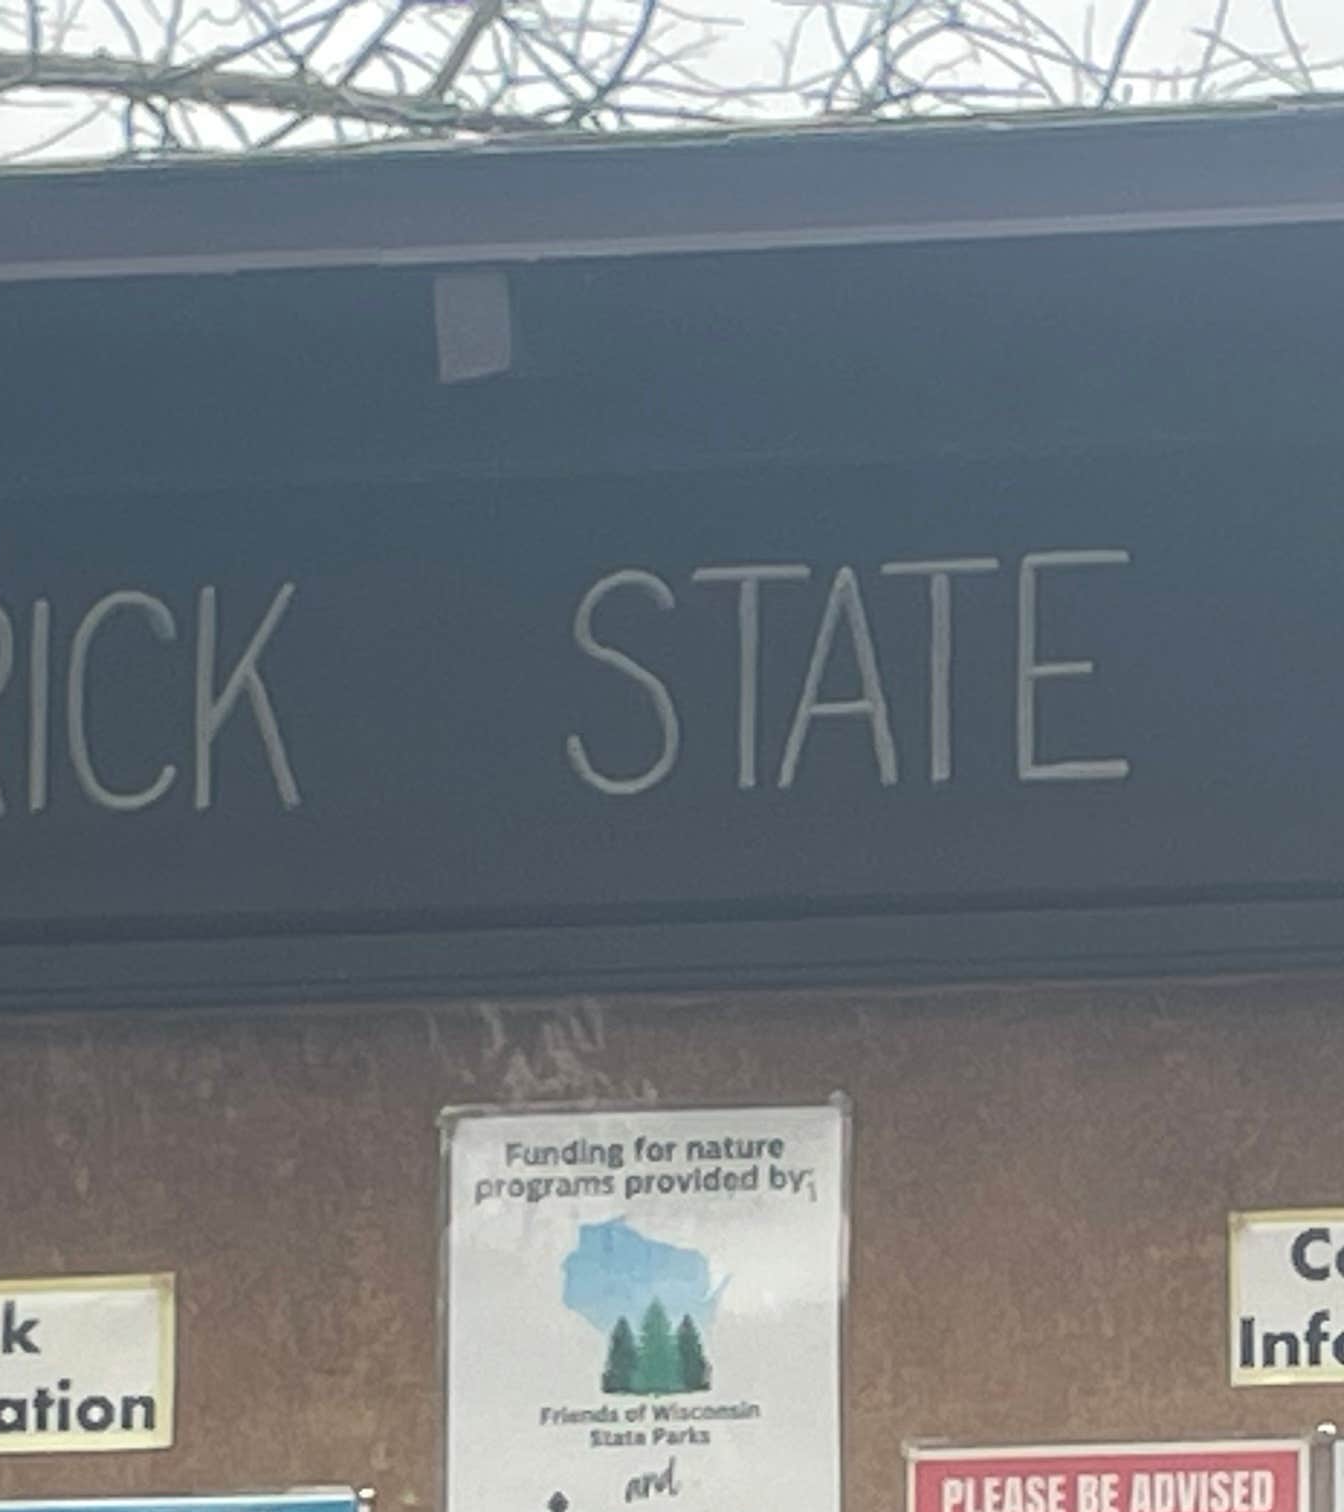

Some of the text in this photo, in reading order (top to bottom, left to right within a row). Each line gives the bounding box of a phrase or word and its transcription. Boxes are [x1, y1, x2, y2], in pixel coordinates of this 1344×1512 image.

[564, 549, 1131, 796] STATE
[505, 1137, 785, 1169] Funding for nature
[474, 1171, 616, 1204] programs
[624, 1164, 758, 1200] provided
[625, 1404, 646, 1423] of
[652, 1427, 711, 1446] Parks
